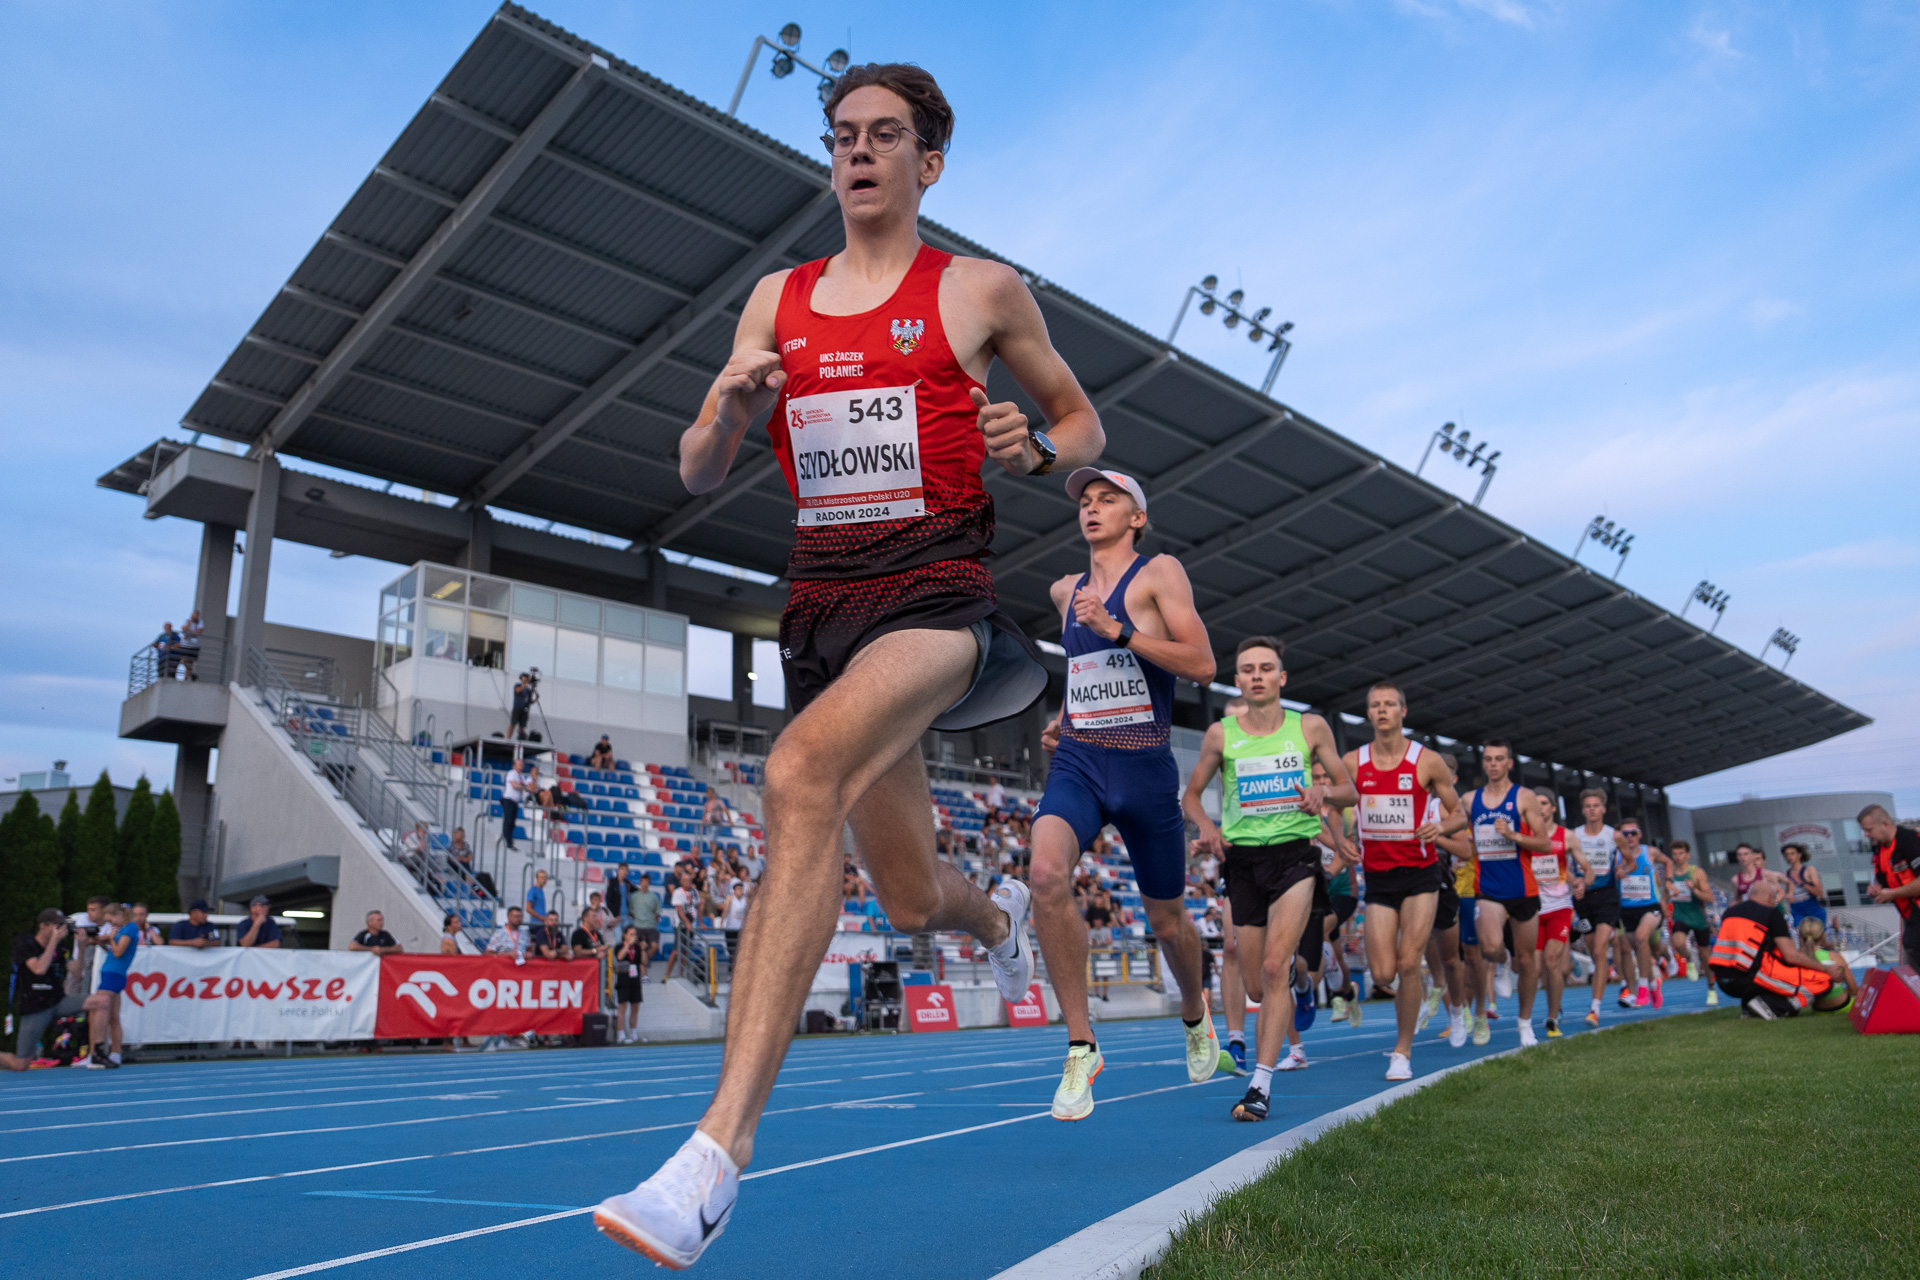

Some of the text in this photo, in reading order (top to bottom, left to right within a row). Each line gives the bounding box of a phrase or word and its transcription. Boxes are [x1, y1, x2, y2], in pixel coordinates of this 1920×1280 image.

[820, 350, 864, 364] UKS ŻACZEK
[819, 364, 864, 379] POŁANIEC
[848, 396, 903, 424] 543
[799, 442, 915, 480] SZYDŁOWSKI
[823, 494, 867, 505] Mistrzostwa
[868, 492, 892, 502] Polski
[893, 490, 911, 499] U20
[816, 506, 890, 521] RADOM 2024
[1106, 652, 1136, 669] 491
[1071, 678, 1146, 704] MACHULEC
[1084, 716, 1134, 726] RADOM 2024
[1274, 756, 1298, 769] 165
[1240, 775, 1303, 796] ZAWIŚLAK
[1389, 797, 1408, 807] 311
[1367, 813, 1405, 824] KILIAN
[468, 978, 583, 1010] ORLEN
